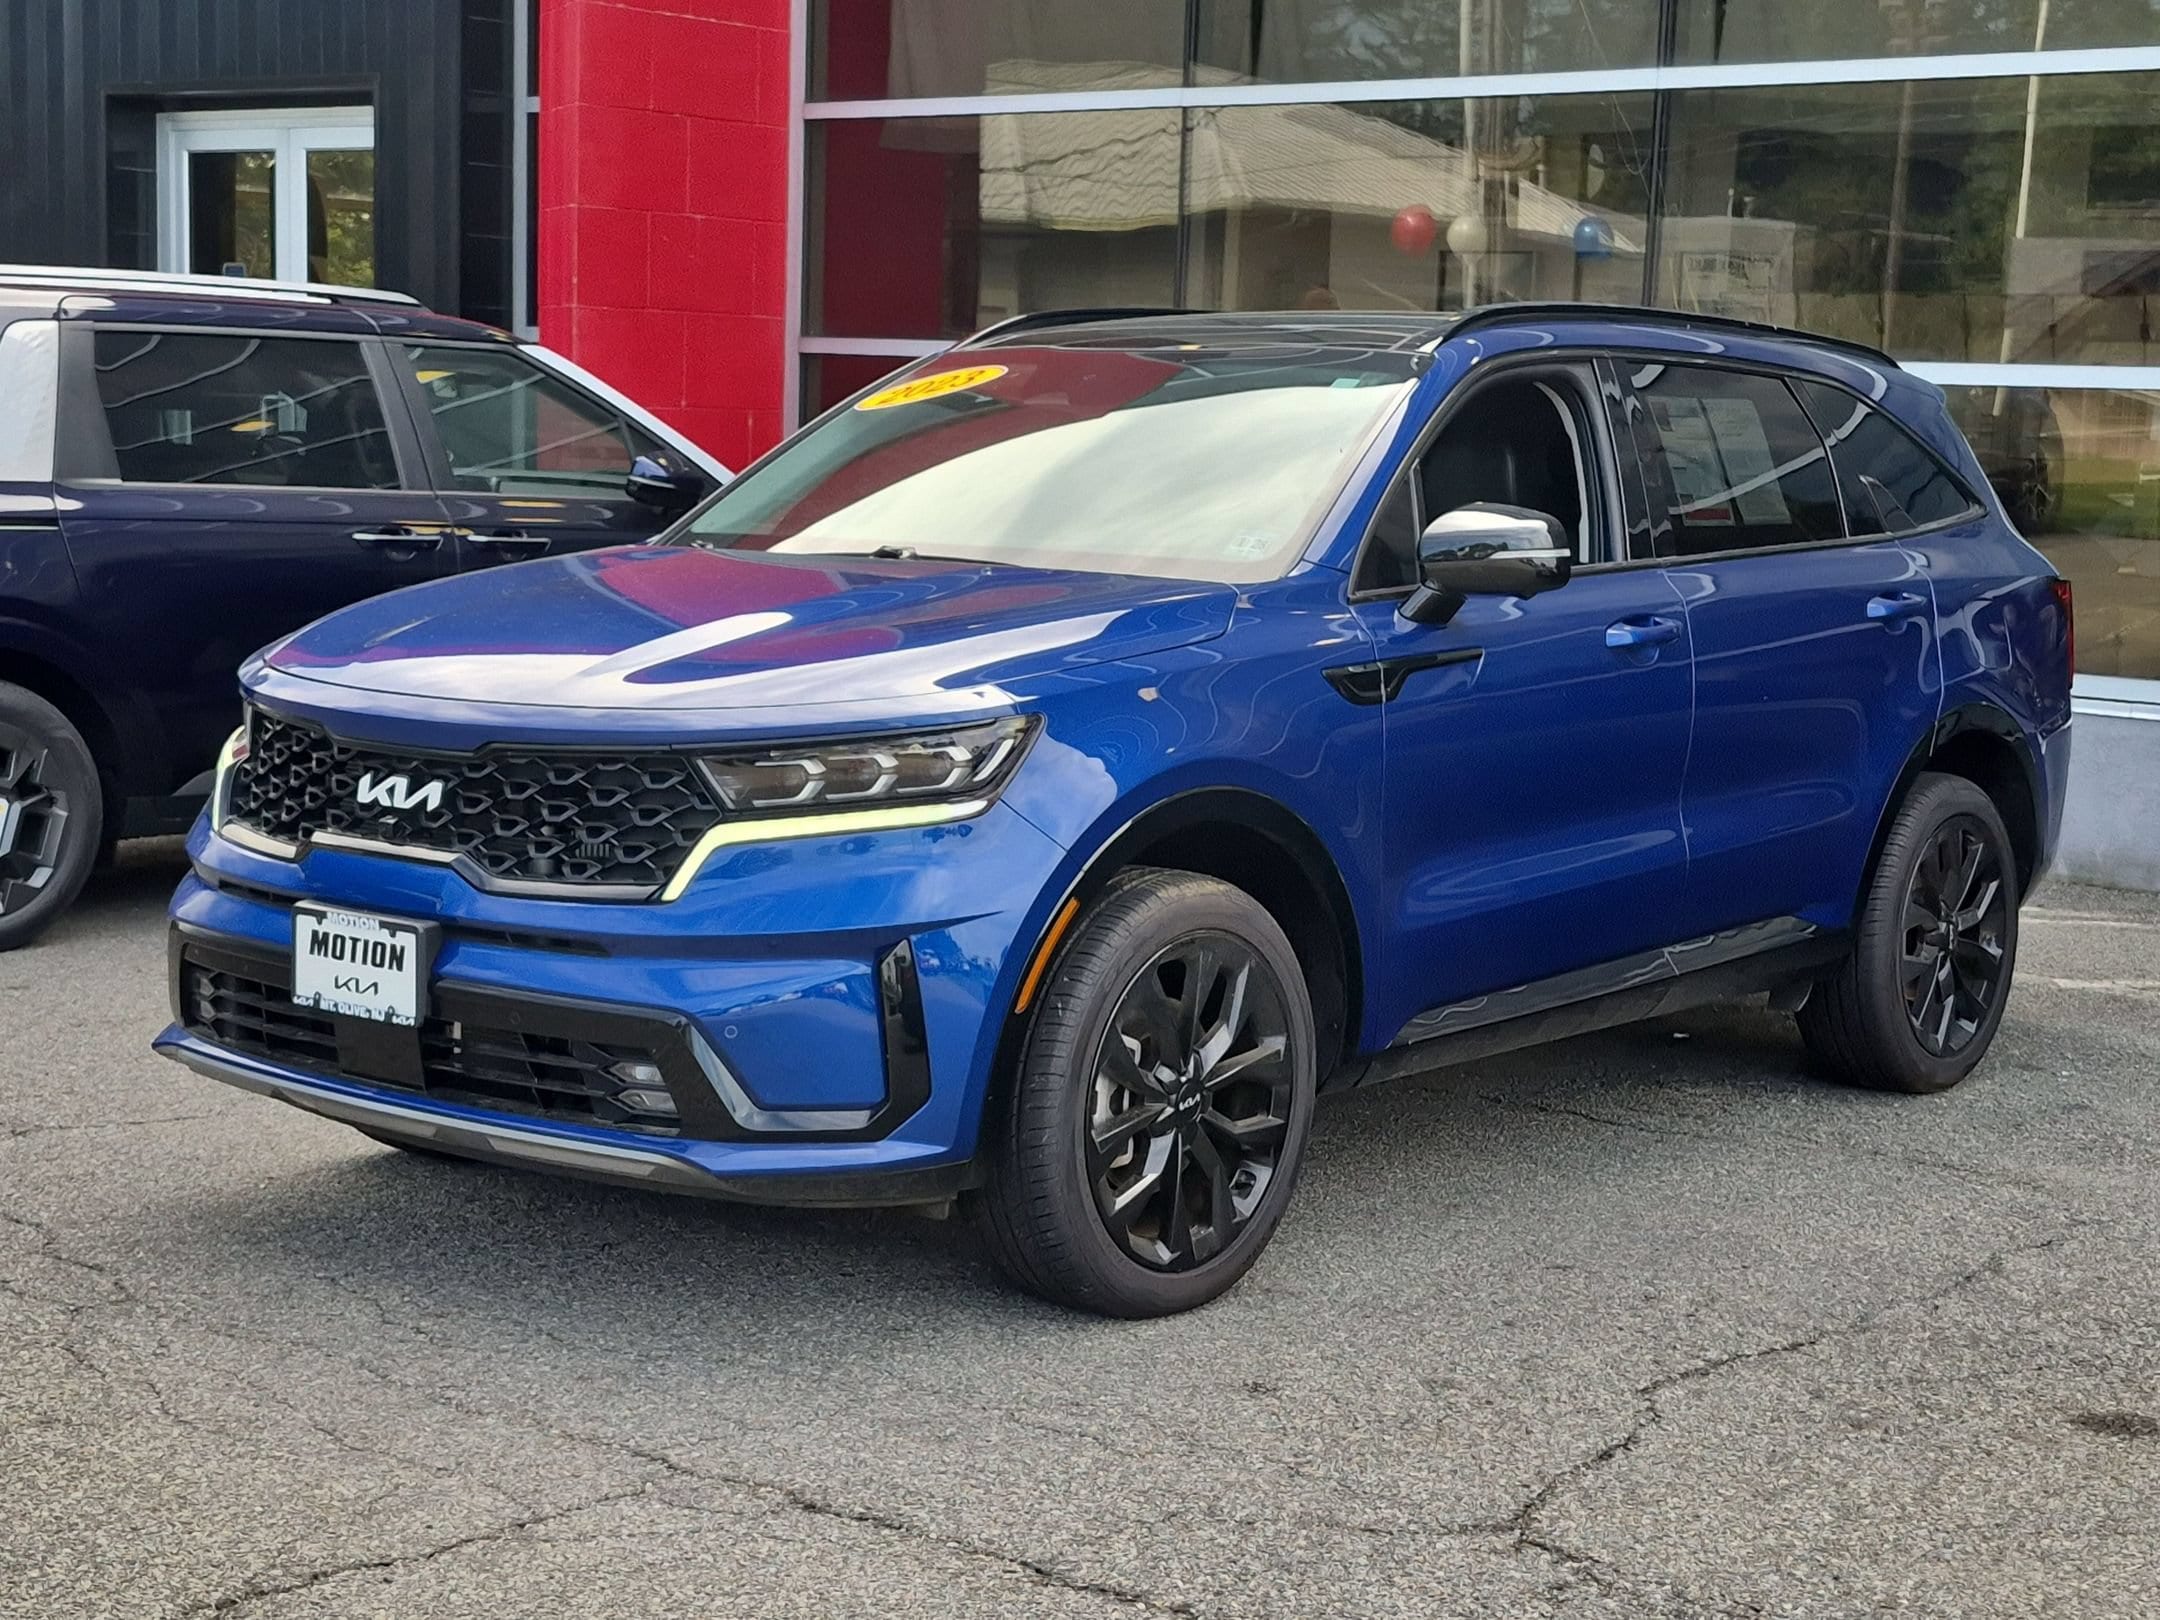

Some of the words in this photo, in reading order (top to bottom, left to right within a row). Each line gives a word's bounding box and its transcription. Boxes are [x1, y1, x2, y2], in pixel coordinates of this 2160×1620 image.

[877, 370, 986, 405] 2023
[357, 771, 444, 812] KIA
[326, 911, 380, 931] MOTION
[308, 928, 406, 972] MOTION
[334, 974, 379, 997] KIA
